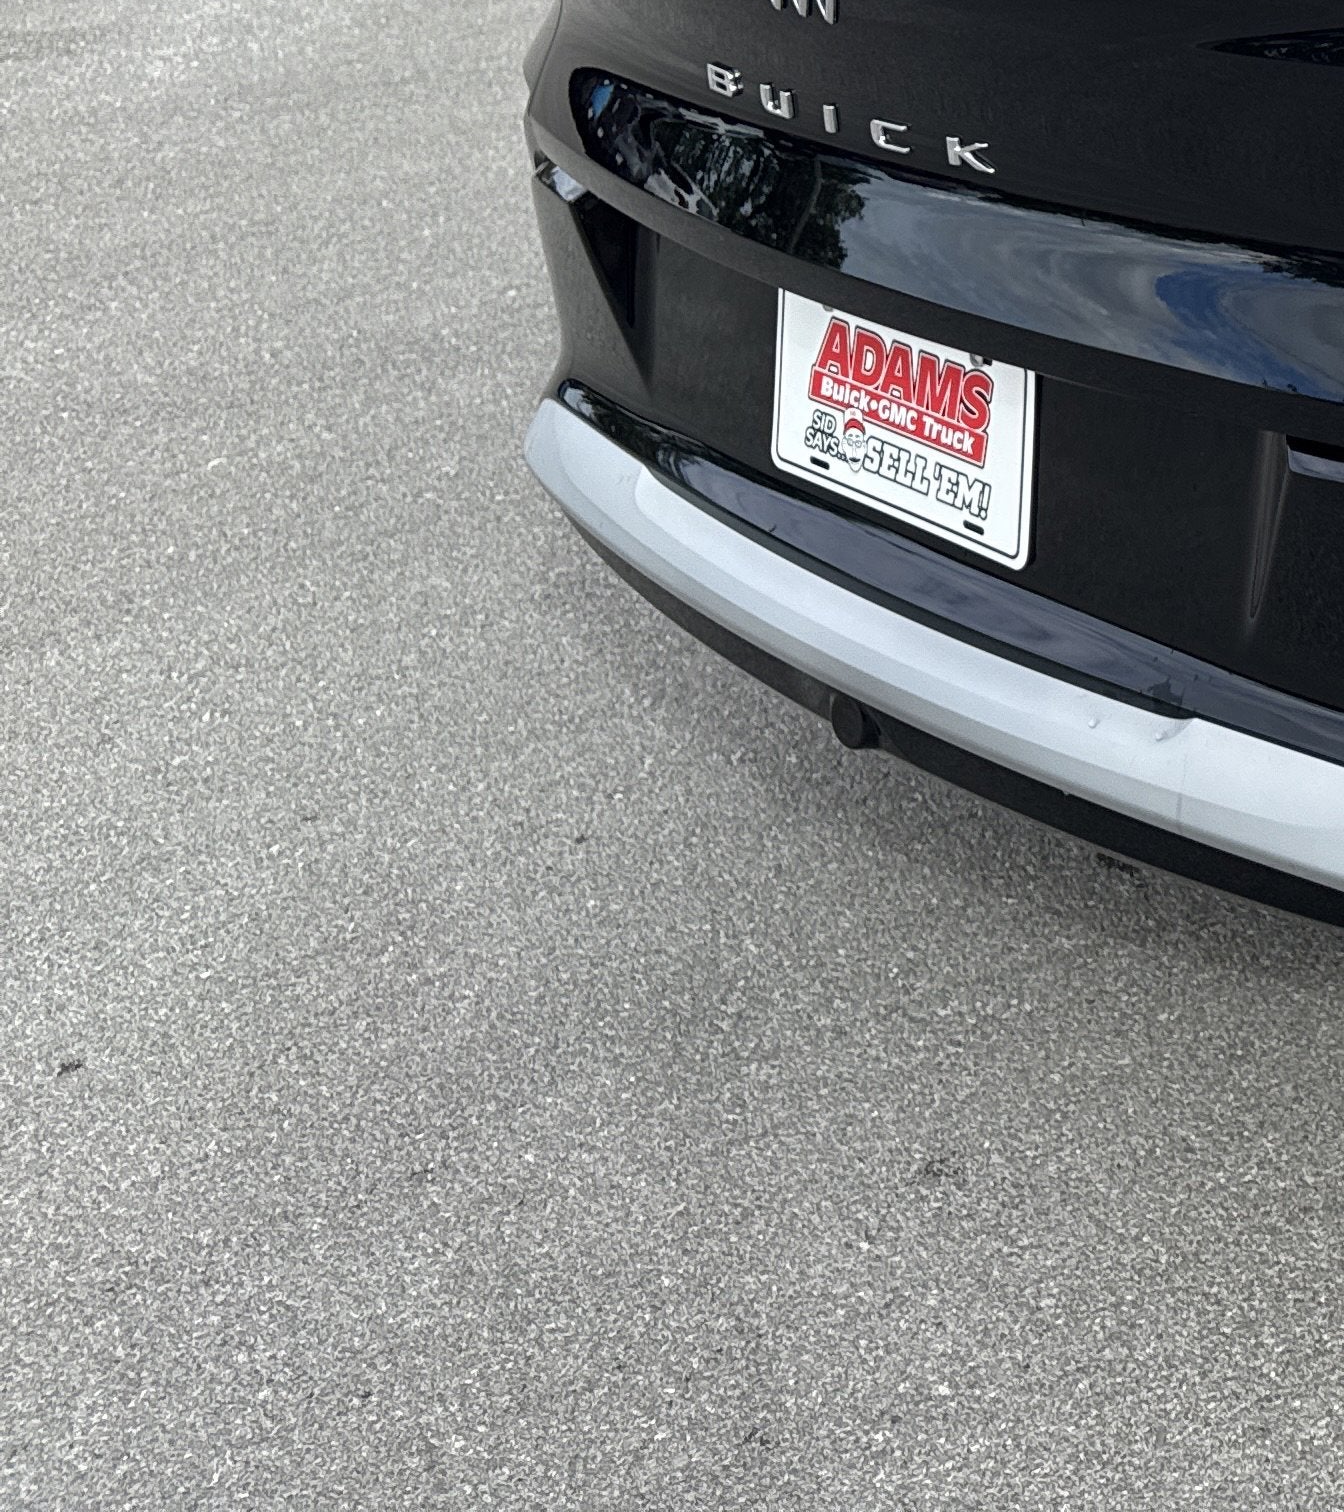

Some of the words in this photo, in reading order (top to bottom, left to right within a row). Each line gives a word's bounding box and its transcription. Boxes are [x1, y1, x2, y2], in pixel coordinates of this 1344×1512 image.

[706, 62, 996, 174] BUICK
[812, 316, 994, 432] ADAMS
[811, 410, 837, 434] SID
[922, 414, 976, 456] Truck
[862, 436, 931, 496] SELL
[933, 462, 992, 520] 'EM!
